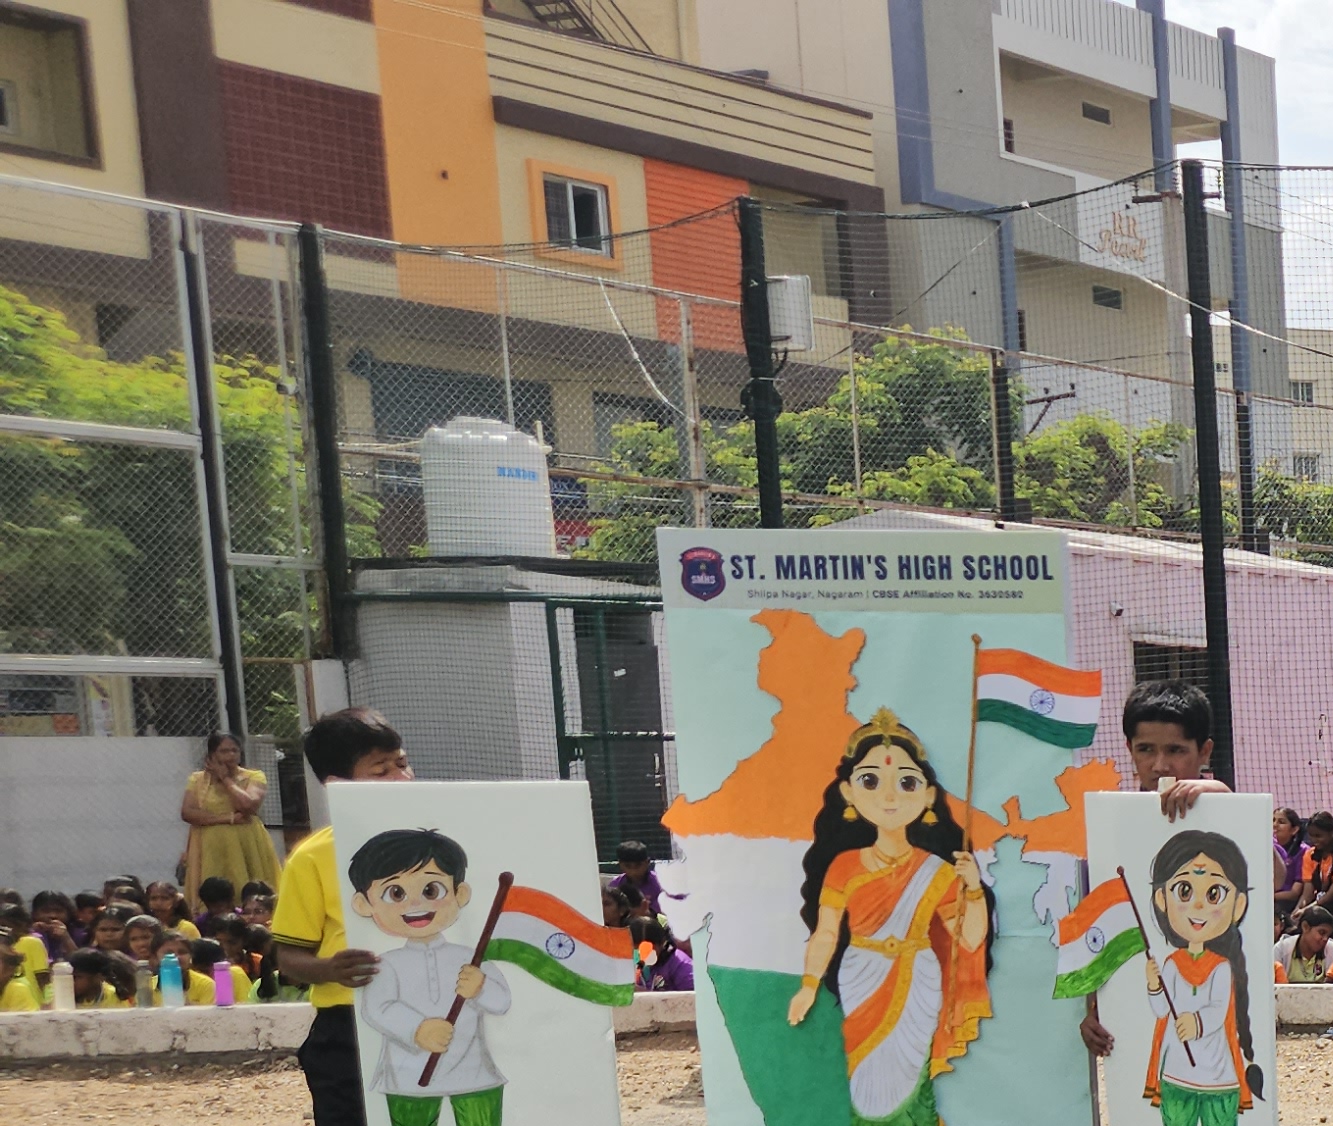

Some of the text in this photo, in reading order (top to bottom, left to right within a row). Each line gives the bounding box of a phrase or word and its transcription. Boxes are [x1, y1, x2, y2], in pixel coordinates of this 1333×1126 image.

[730, 554, 1054, 581] ST. MARTIN'S HIGH SCHOOL
[817, 589, 864, 600] Nagaram
[872, 590, 900, 599] CBSE
[903, 590, 955, 599] Affiliation
